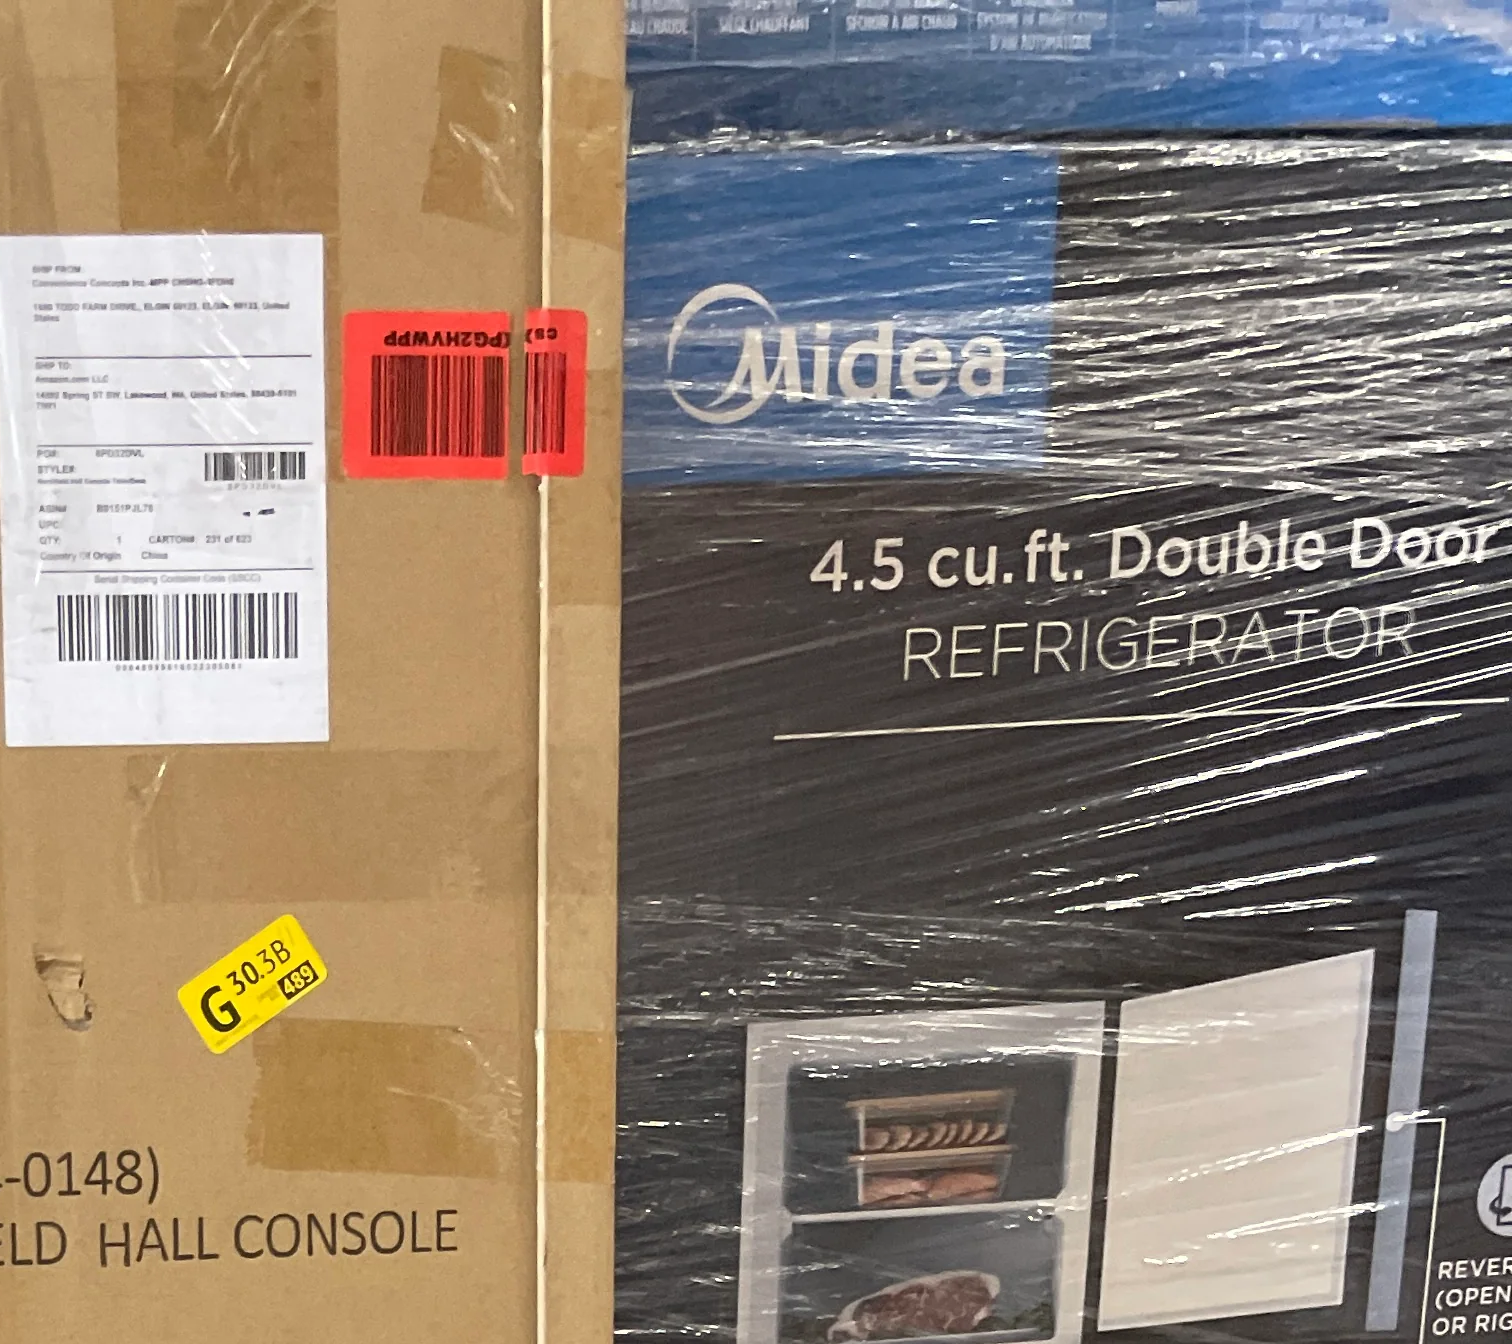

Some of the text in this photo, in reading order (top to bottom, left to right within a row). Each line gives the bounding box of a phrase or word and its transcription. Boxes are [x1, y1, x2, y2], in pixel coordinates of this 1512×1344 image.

[706, 319, 1007, 407] Midea
[810, 516, 1502, 593] 4.5 cu.ft. Double Door
[903, 606, 1417, 682] REFRIGERATOR
[283, 964, 314, 995] 489
[201, 985, 242, 1033] G
[99, 1216, 220, 1268] HALL
[233, 1209, 459, 1260] CONSOLE
[1432, 1312, 1512, 1336] OR RIG
[1435, 1285, 1512, 1310] (OPEN
